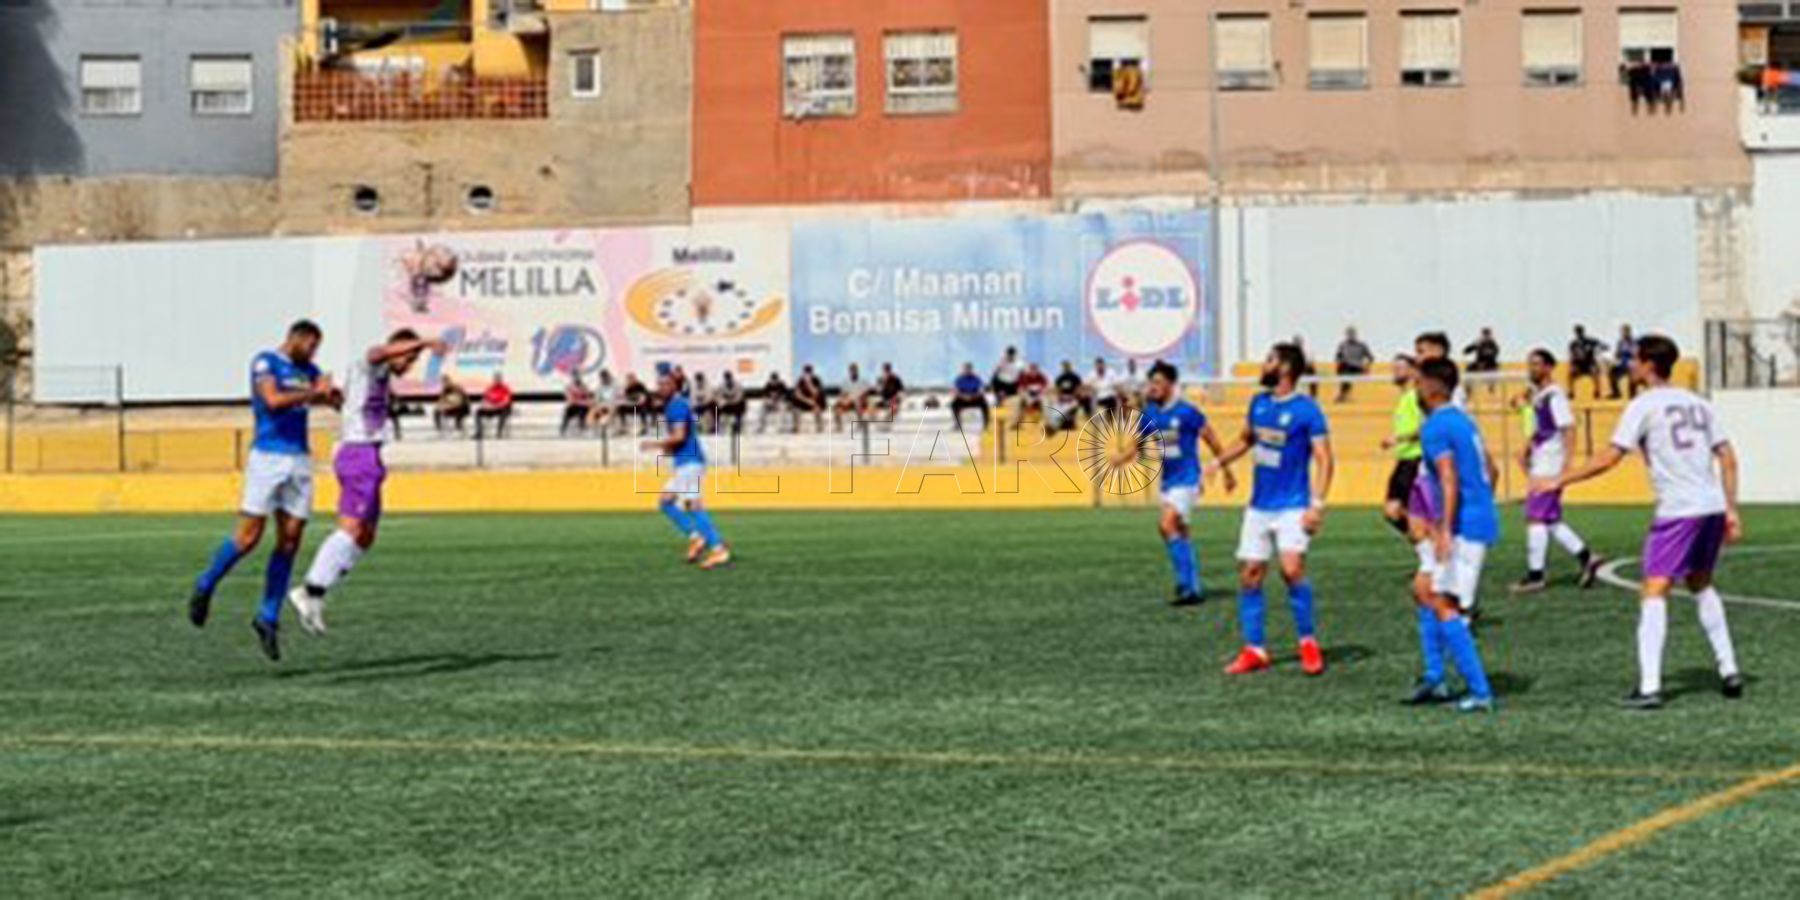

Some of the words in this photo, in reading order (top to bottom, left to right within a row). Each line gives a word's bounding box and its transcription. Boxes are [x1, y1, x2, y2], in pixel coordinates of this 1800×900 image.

[673, 248, 735, 263] Melilla
[459, 266, 596, 296] MELILLA
[847, 269, 884, 298] C/
[894, 267, 1023, 297] Maanan
[1096, 276, 1187, 312] LIDL
[808, 303, 941, 334] Benaisa
[952, 301, 1064, 331] Mimun
[1665, 404, 1711, 450] 24
